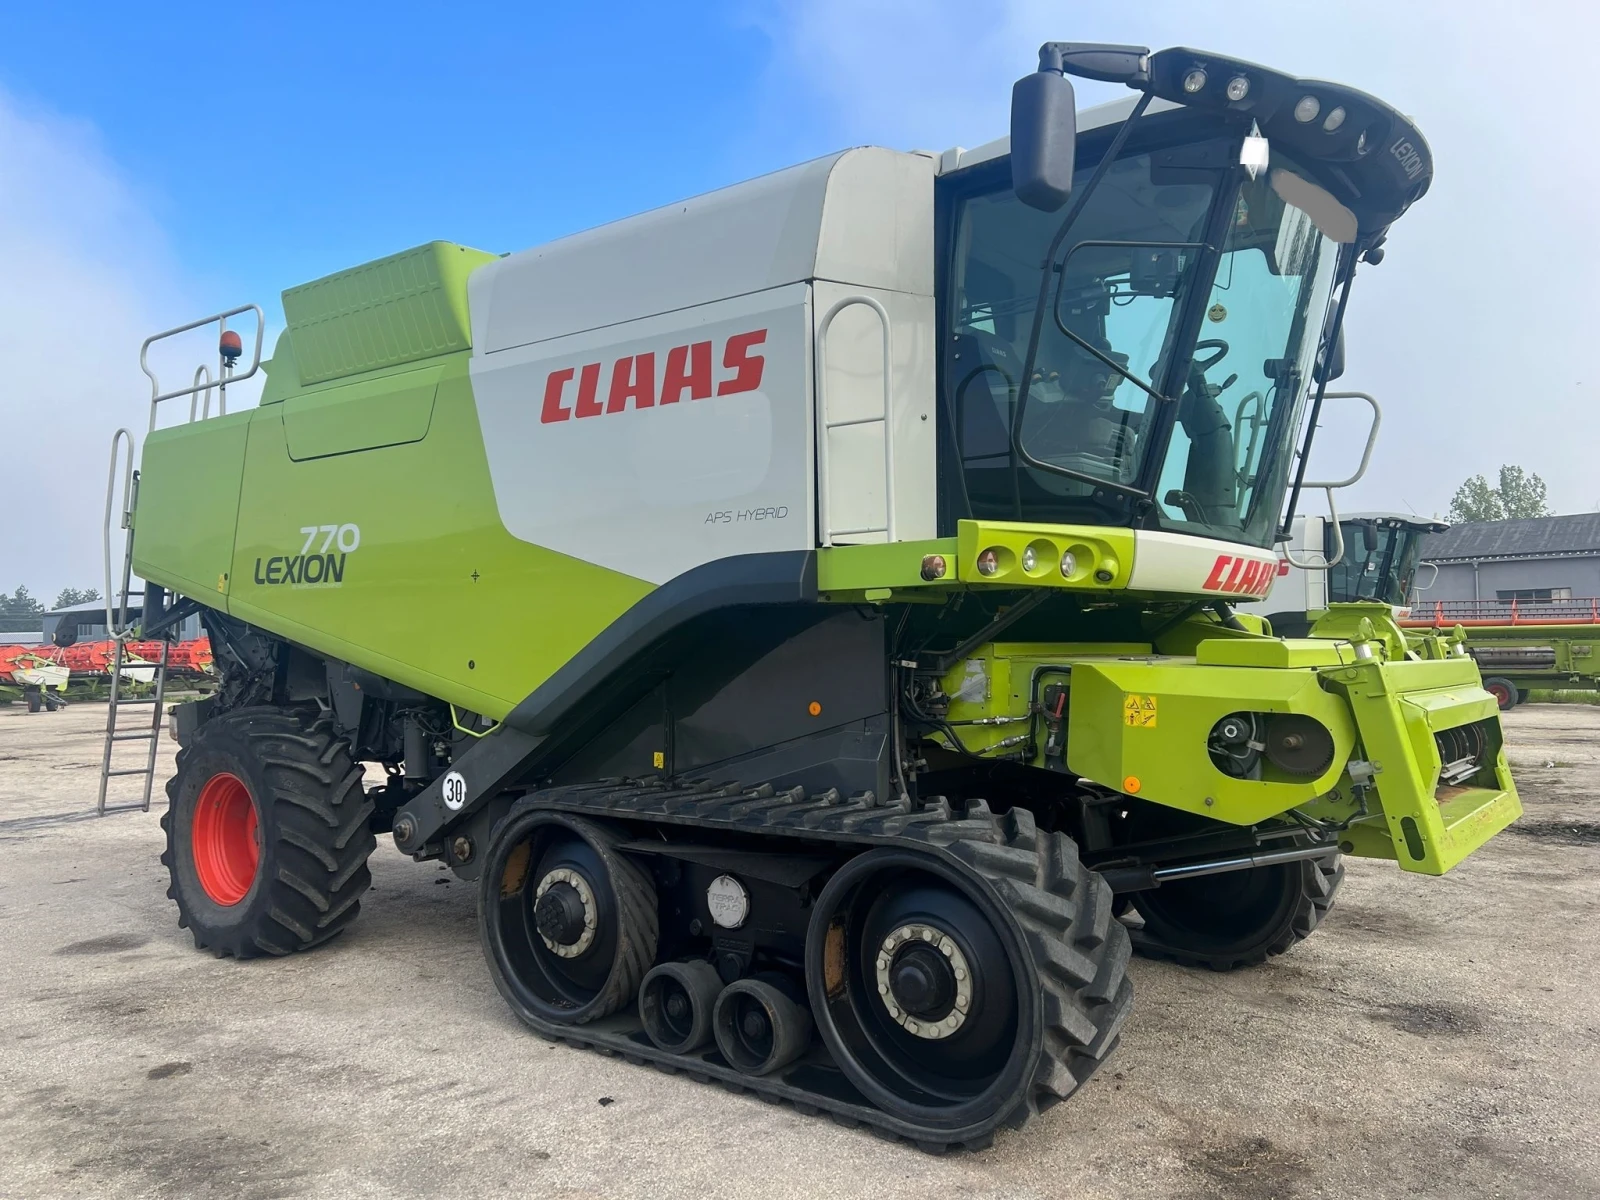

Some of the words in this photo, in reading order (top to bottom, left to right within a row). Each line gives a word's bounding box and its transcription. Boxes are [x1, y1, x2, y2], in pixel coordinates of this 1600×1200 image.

[1390, 136, 1424, 180] LEXION
[540, 328, 768, 424] CLAAS
[704, 511, 732, 524] APS
[737, 506, 788, 522] HYBRID
[300, 523, 360, 555] 770
[254, 553, 346, 585] LEXION
[446, 778, 462, 803] 30
